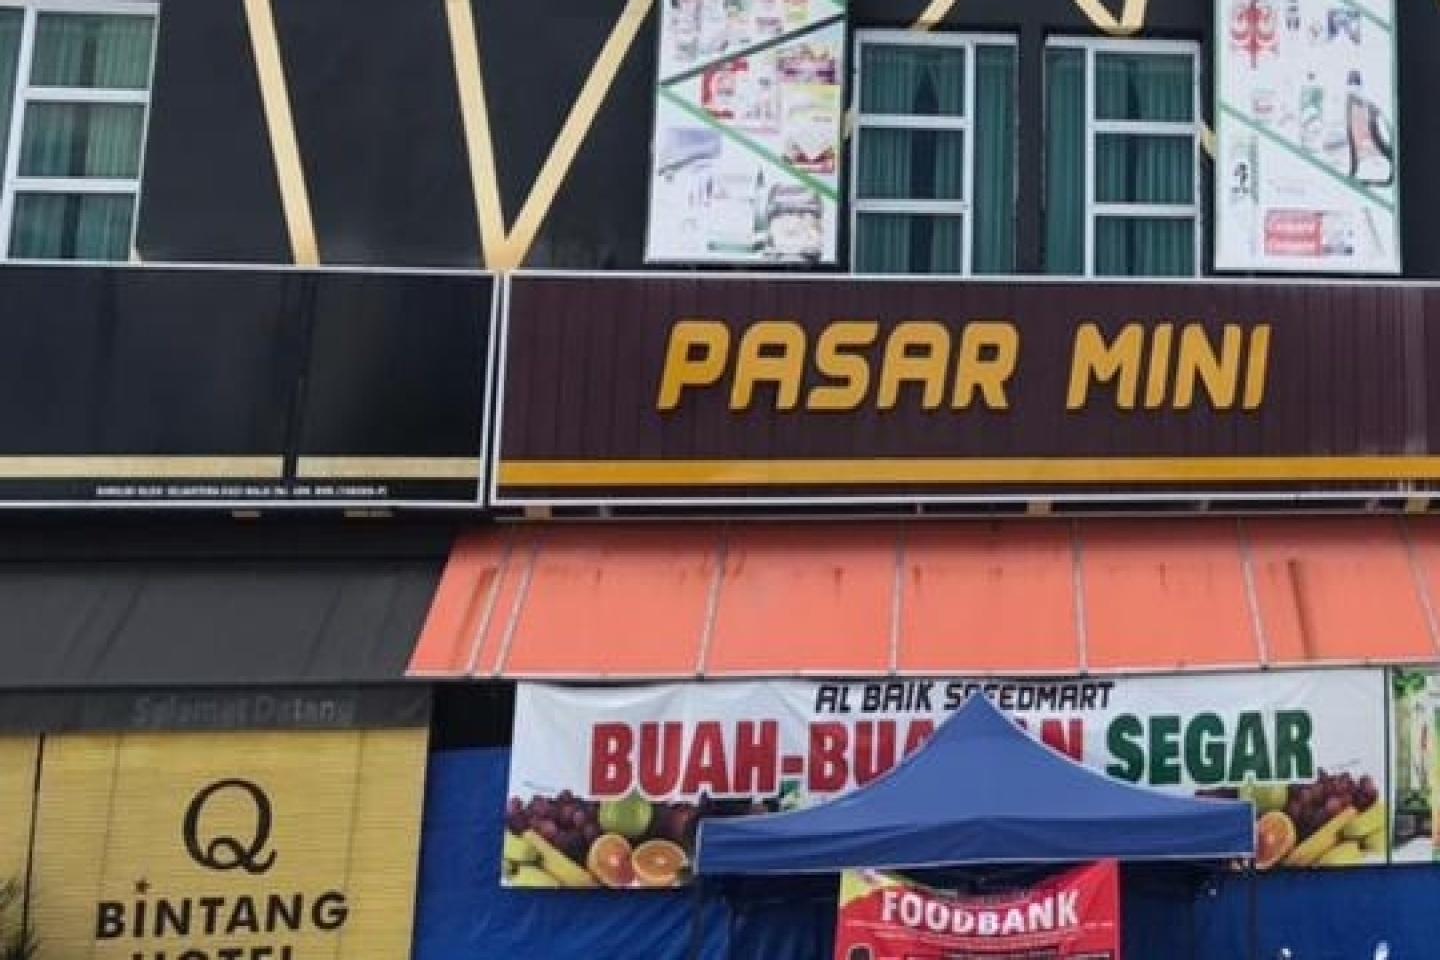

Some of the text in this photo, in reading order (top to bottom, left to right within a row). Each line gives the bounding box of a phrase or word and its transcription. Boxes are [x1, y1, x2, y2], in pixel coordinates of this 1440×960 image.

[656, 320, 1272, 410] PASAR MINI
[815, 683, 851, 714] AL
[861, 681, 935, 713] BAIK
[1106, 709, 1314, 786] SEGAR
[183, 778, 278, 876] Q
[95, 883, 350, 941] BINTANG
[881, 888, 1082, 937] FOODBANK
